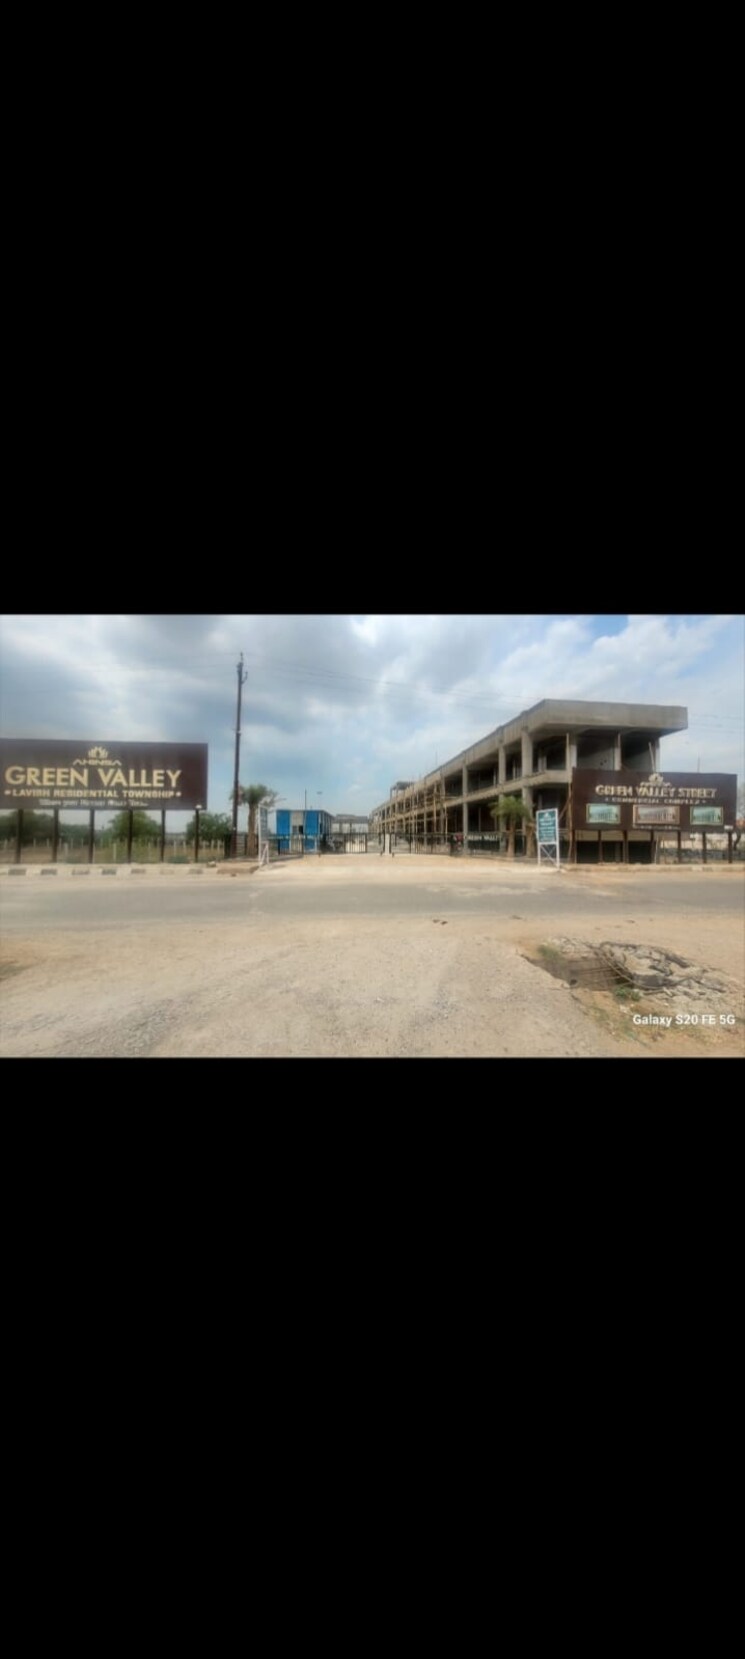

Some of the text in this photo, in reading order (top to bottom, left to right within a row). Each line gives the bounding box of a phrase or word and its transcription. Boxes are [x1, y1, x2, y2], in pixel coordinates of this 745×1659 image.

[5, 766, 182, 788] GREEN VALLEY
[12, 789, 175, 798] LAVISH RESIDENTIAL TOWNSHIP
[595, 785, 717, 798] GREEN VALLEY STREET
